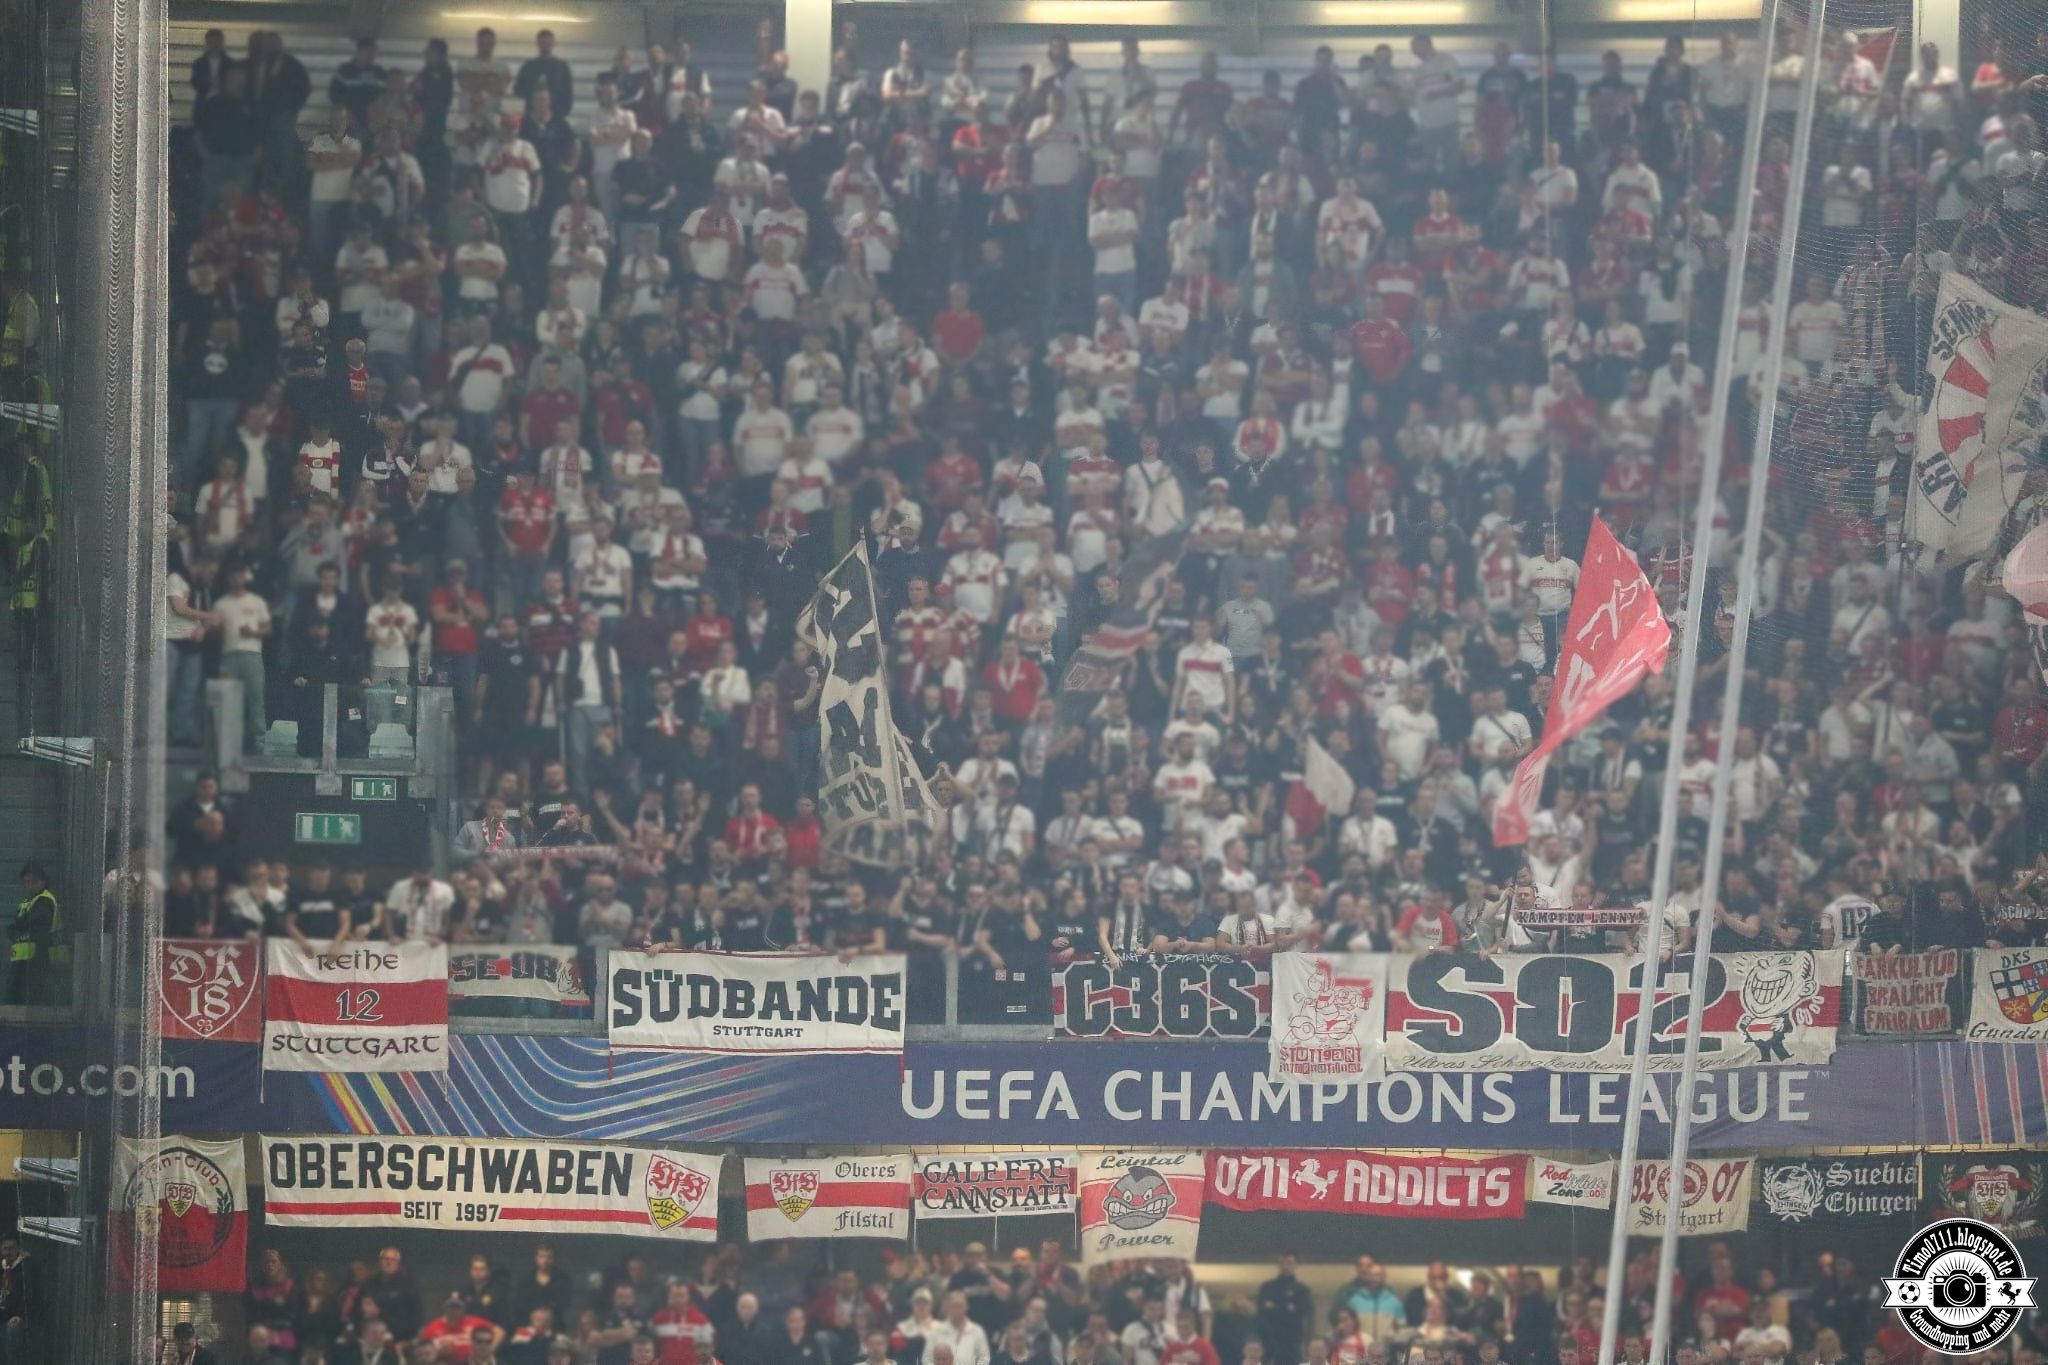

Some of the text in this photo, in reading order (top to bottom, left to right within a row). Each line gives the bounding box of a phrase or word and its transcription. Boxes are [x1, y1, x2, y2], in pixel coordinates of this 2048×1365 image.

[2001, 950, 2031, 969] DKS
[336, 988, 383, 1021] 12
[612, 968, 901, 1033] SÜDBANDE
[1867, 982, 1945, 1006] BRAUCHT
[713, 1025, 804, 1038] STUTTGART
[1401, 1055, 1465, 1069] Ultras
[0, 1056, 195, 1098] to.com
[903, 1070, 1080, 1121] UEFA
[1104, 1070, 1517, 1124] CHAMPIONS
[268, 1142, 634, 1197] OBERSCHWABEN
[835, 1161, 896, 1178] Oberes
[923, 1157, 1069, 1184] GALEERE
[1096, 1153, 1186, 1170] Leintal
[1539, 1164, 1573, 1181] Red
[1214, 1155, 1512, 1207] 0711 ADDICTS
[1825, 1161, 1918, 1188] Suebia
[921, 1183, 1070, 1213] CANNSTATT
[1547, 1182, 1584, 1198] Zone
[404, 1201, 499, 1223] SEIT 1997
[834, 1211, 894, 1232] Filstal
[1096, 1231, 1175, 1252] Power
